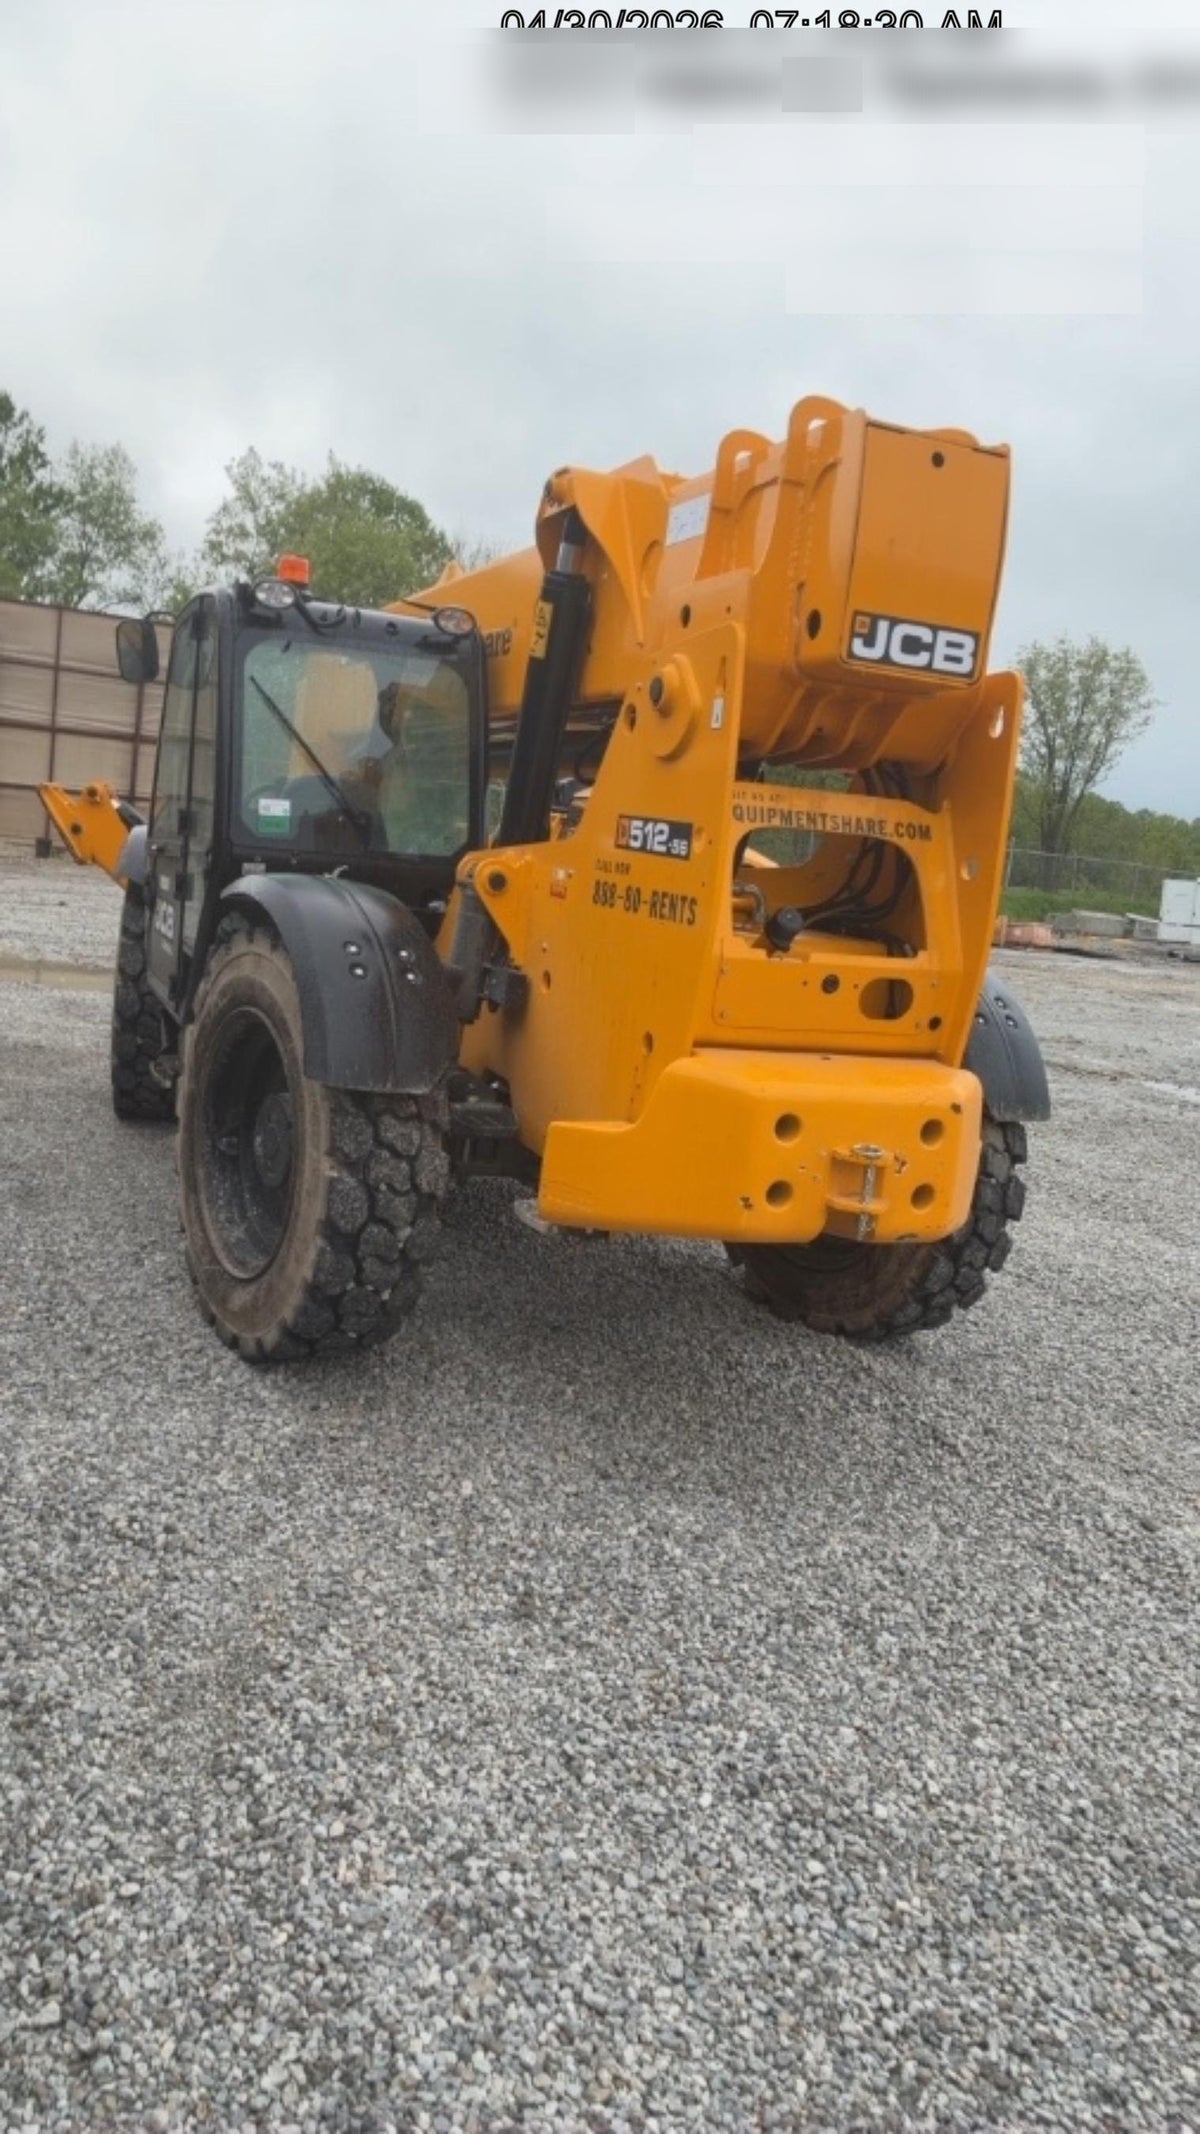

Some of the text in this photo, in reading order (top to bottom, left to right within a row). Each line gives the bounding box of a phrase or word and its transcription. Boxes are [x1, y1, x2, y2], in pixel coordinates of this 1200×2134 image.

[851, 618, 976, 675] JCB
[732, 804, 933, 842] QUIPMENTSHARE.COM
[592, 879, 698, 926] 888-80-RENTS
